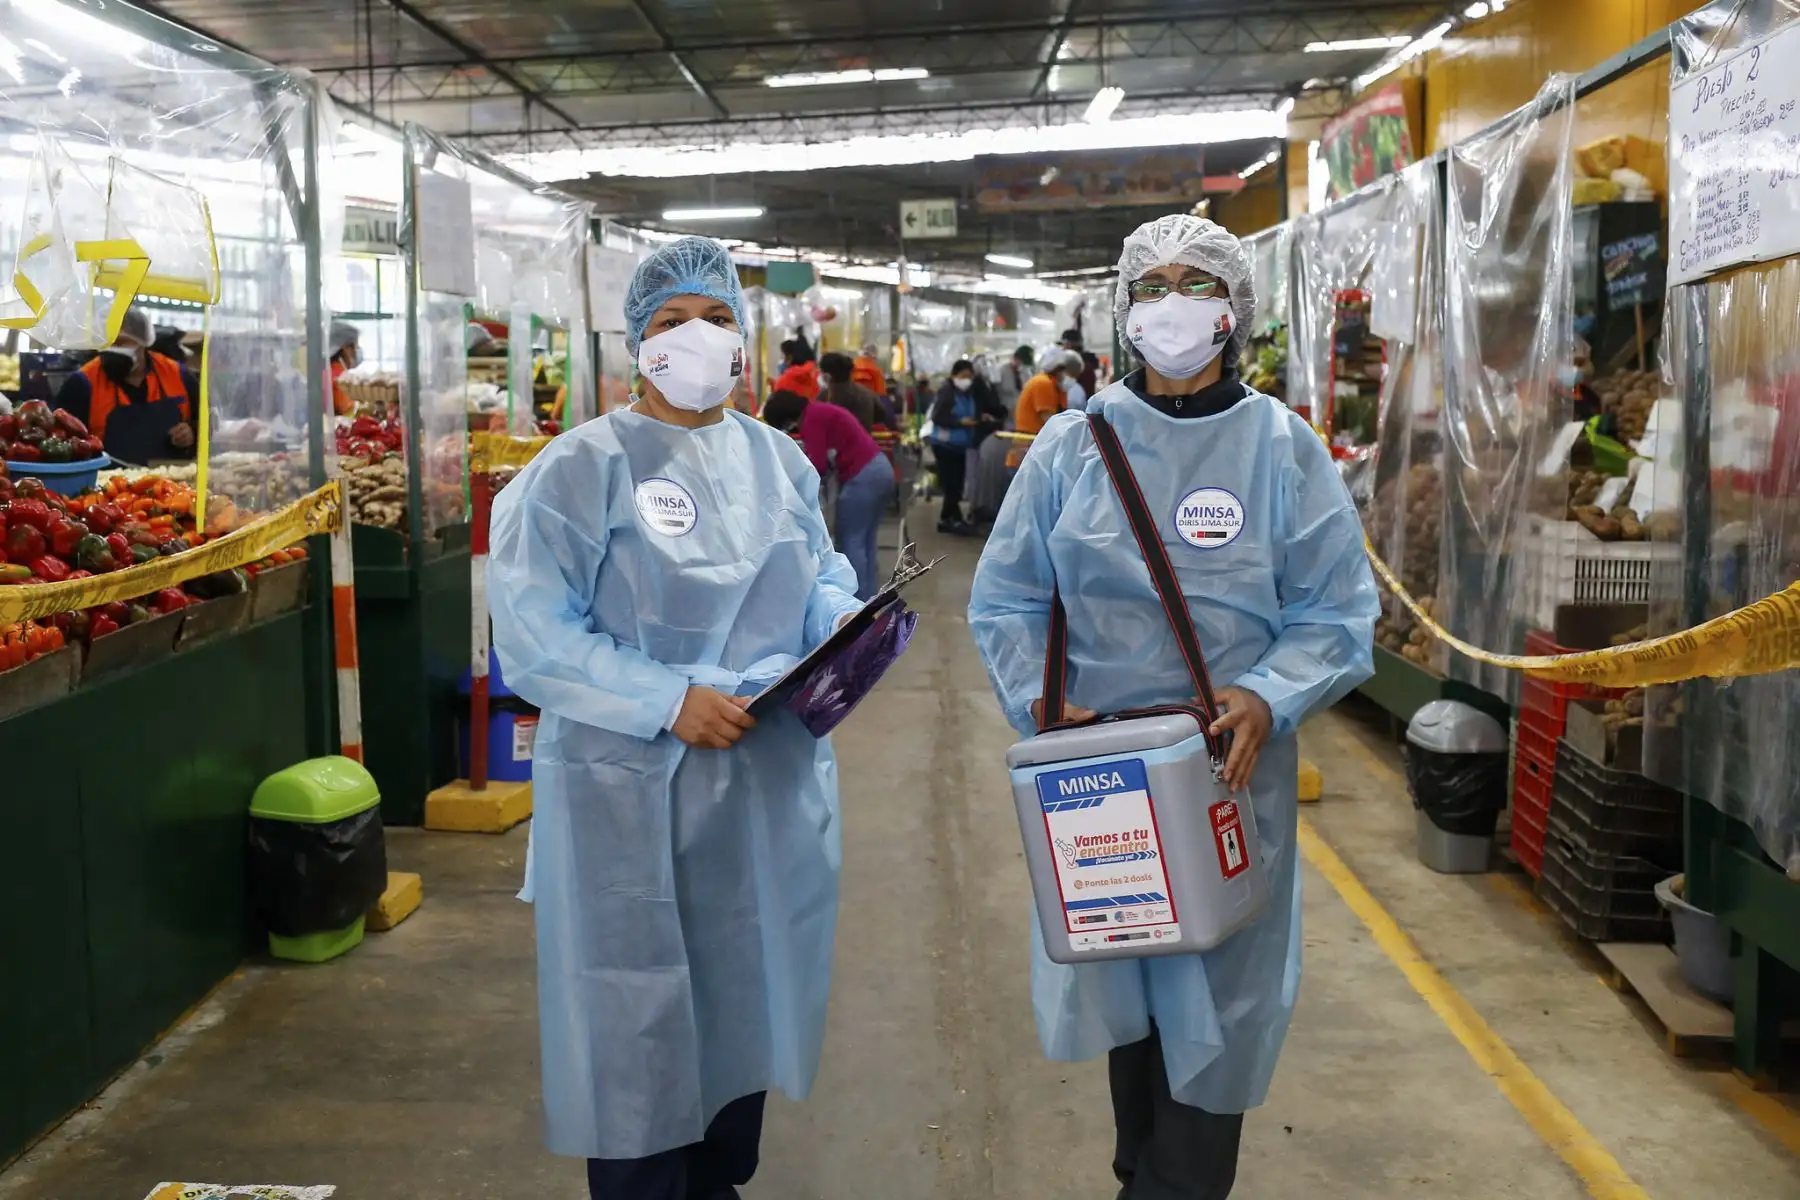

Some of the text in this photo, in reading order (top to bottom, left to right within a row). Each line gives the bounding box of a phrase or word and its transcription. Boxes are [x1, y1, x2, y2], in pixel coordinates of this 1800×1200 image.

[1746, 45, 1760, 83] 2
[1183, 506, 1236, 519] MINSA
[1178, 519, 1200, 527] DIRIS
[1222, 519, 1241, 527] SUR
[1058, 771, 1126, 796] MINSA
[1074, 828, 1149, 848] Vamos a tu
[1080, 840, 1149, 858] encuentro
[1085, 873, 1153, 887] Ponte las 2 dosis
